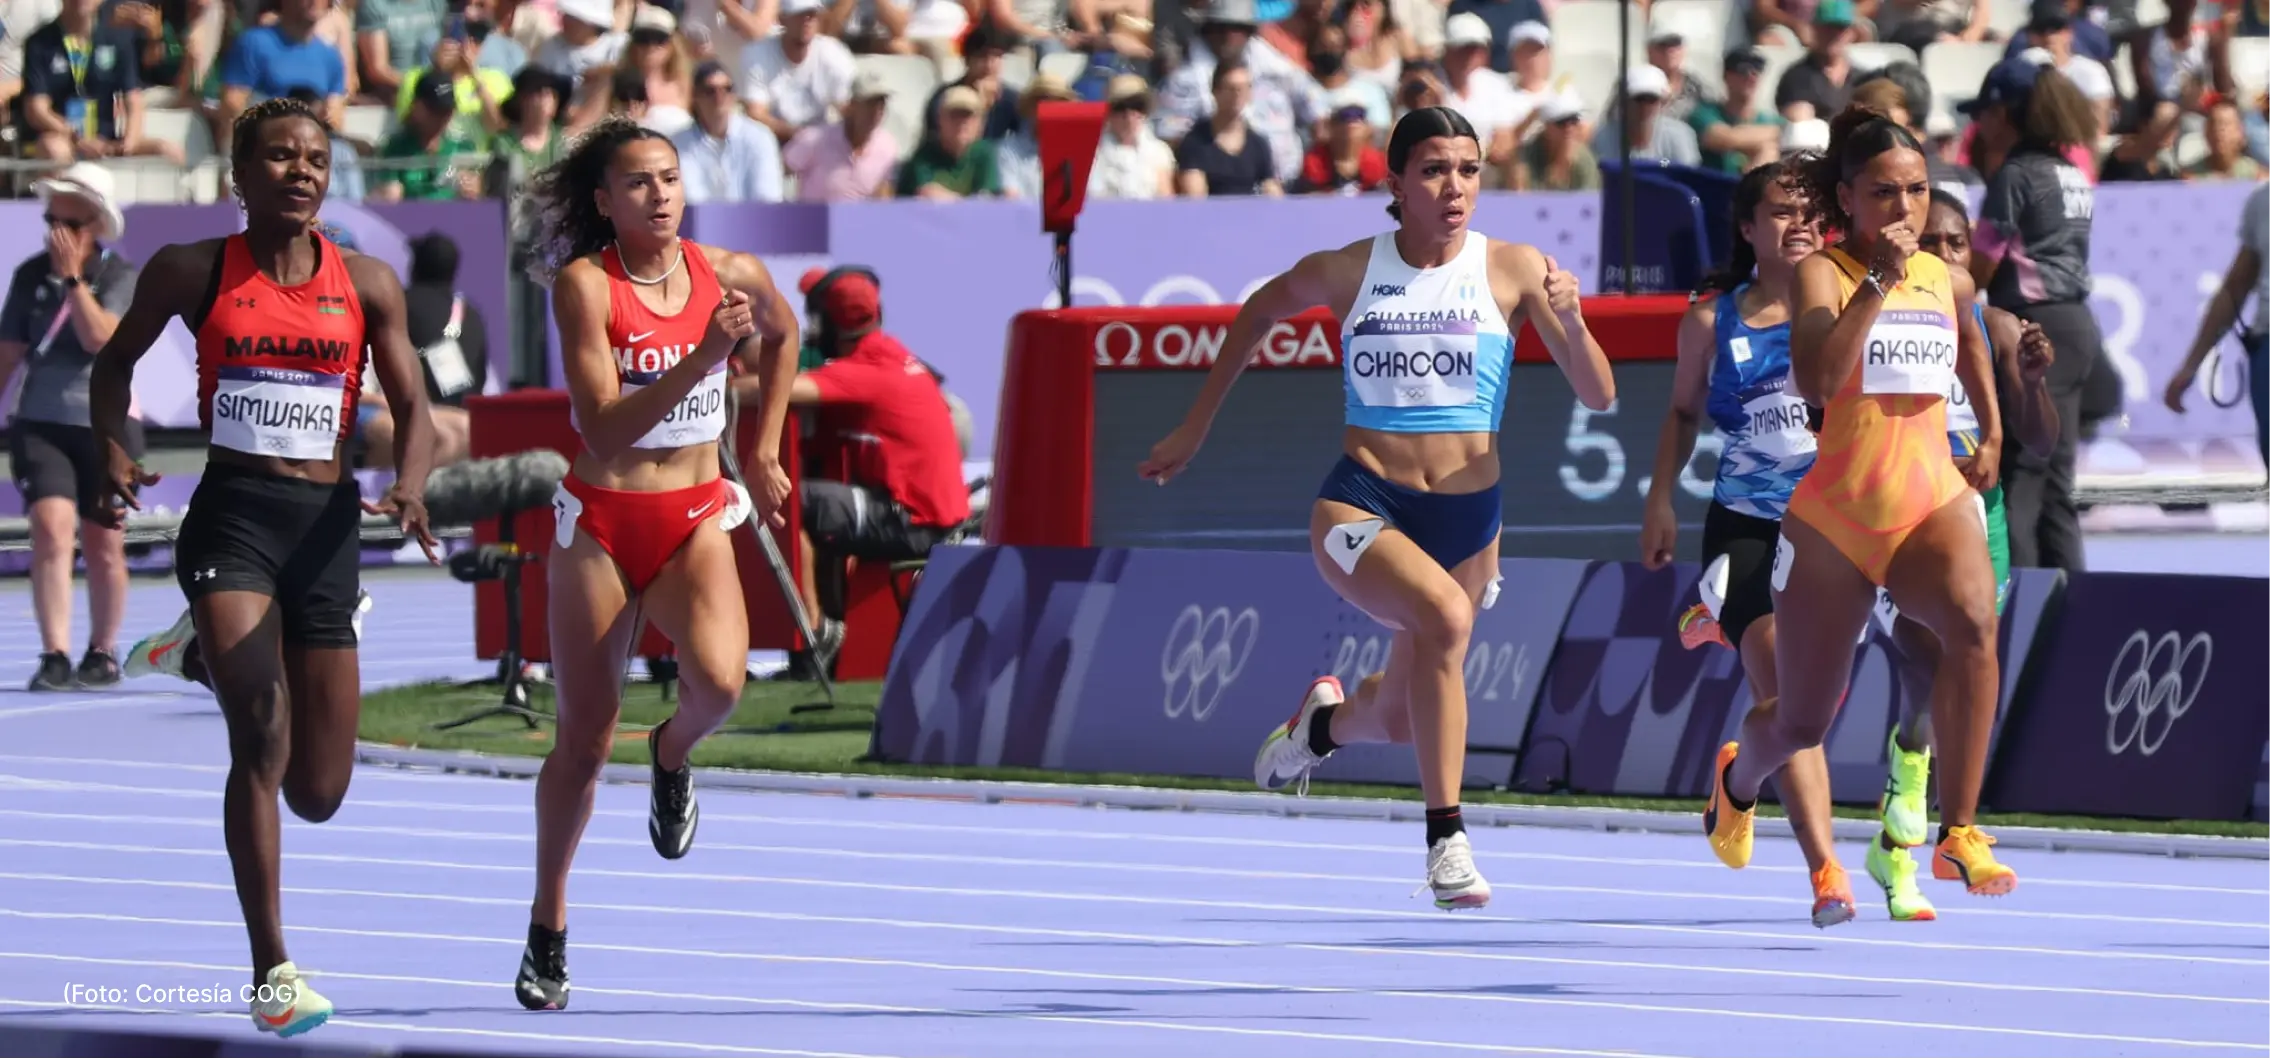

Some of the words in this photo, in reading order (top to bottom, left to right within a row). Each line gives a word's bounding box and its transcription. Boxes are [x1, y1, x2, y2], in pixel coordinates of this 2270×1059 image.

[1371, 284, 1407, 297] HOKA
[1364, 308, 1481, 323] GUATEMALA
[1380, 323, 1413, 332] PARIS
[224, 335, 350, 363] MALAWI
[1153, 321, 1336, 367] OMGA
[1868, 339, 1955, 369] AKAKPO
[1353, 350, 1473, 378] CHACON
[217, 393, 334, 433] SIMWAKA
